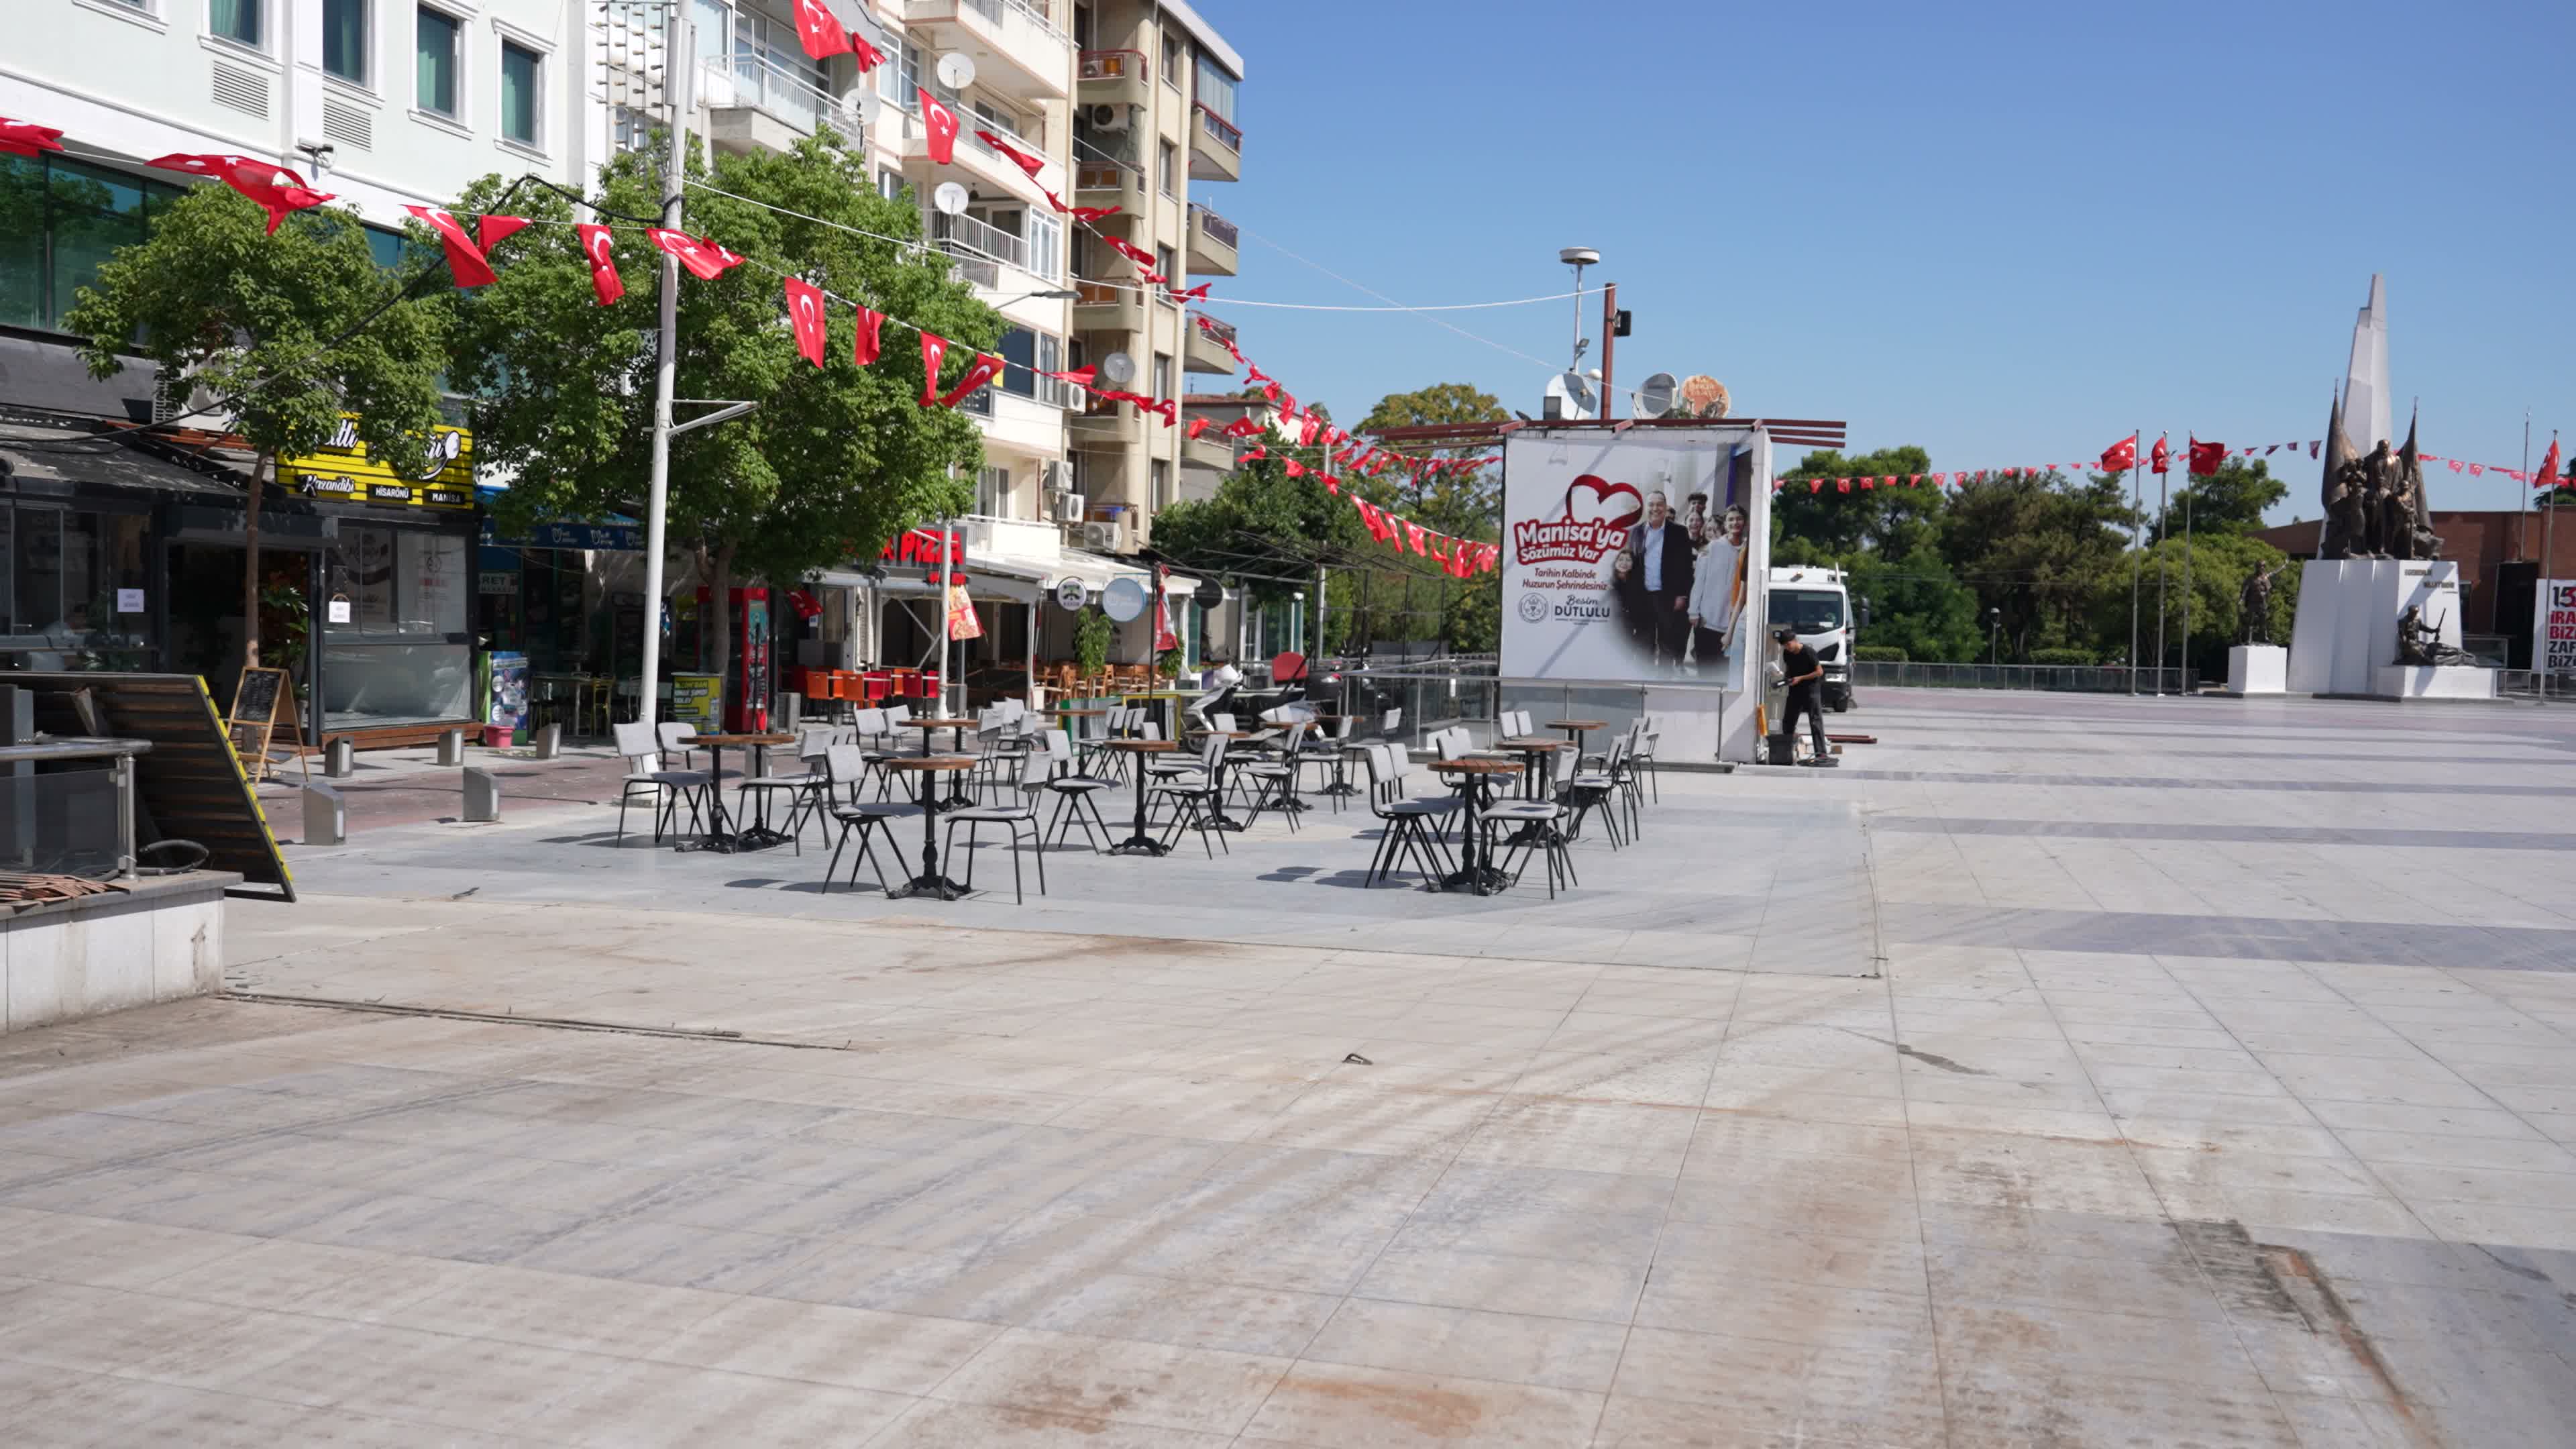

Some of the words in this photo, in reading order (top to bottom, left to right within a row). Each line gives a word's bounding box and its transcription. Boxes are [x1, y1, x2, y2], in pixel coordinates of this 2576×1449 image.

[303, 475, 355, 496] Kazandibi
[376, 486, 409, 498] HİSARÖNÜ
[432, 493, 460, 502] MANİSA
[1517, 519, 1625, 548] Manisa'ya
[1520, 543, 1576, 561] Sözümüz
[1578, 545, 1599, 560] Var
[1535, 568, 1560, 578] Tarihin
[1562, 569, 1597, 579] Kalbinde
[1523, 578, 1555, 588] Huzurun
[1556, 580, 1608, 590] Şehrindesiniz
[1566, 594, 1598, 606] Besim
[1555, 606, 1610, 617] DUTLULU
[2550, 625, 2576, 639] BİZ
